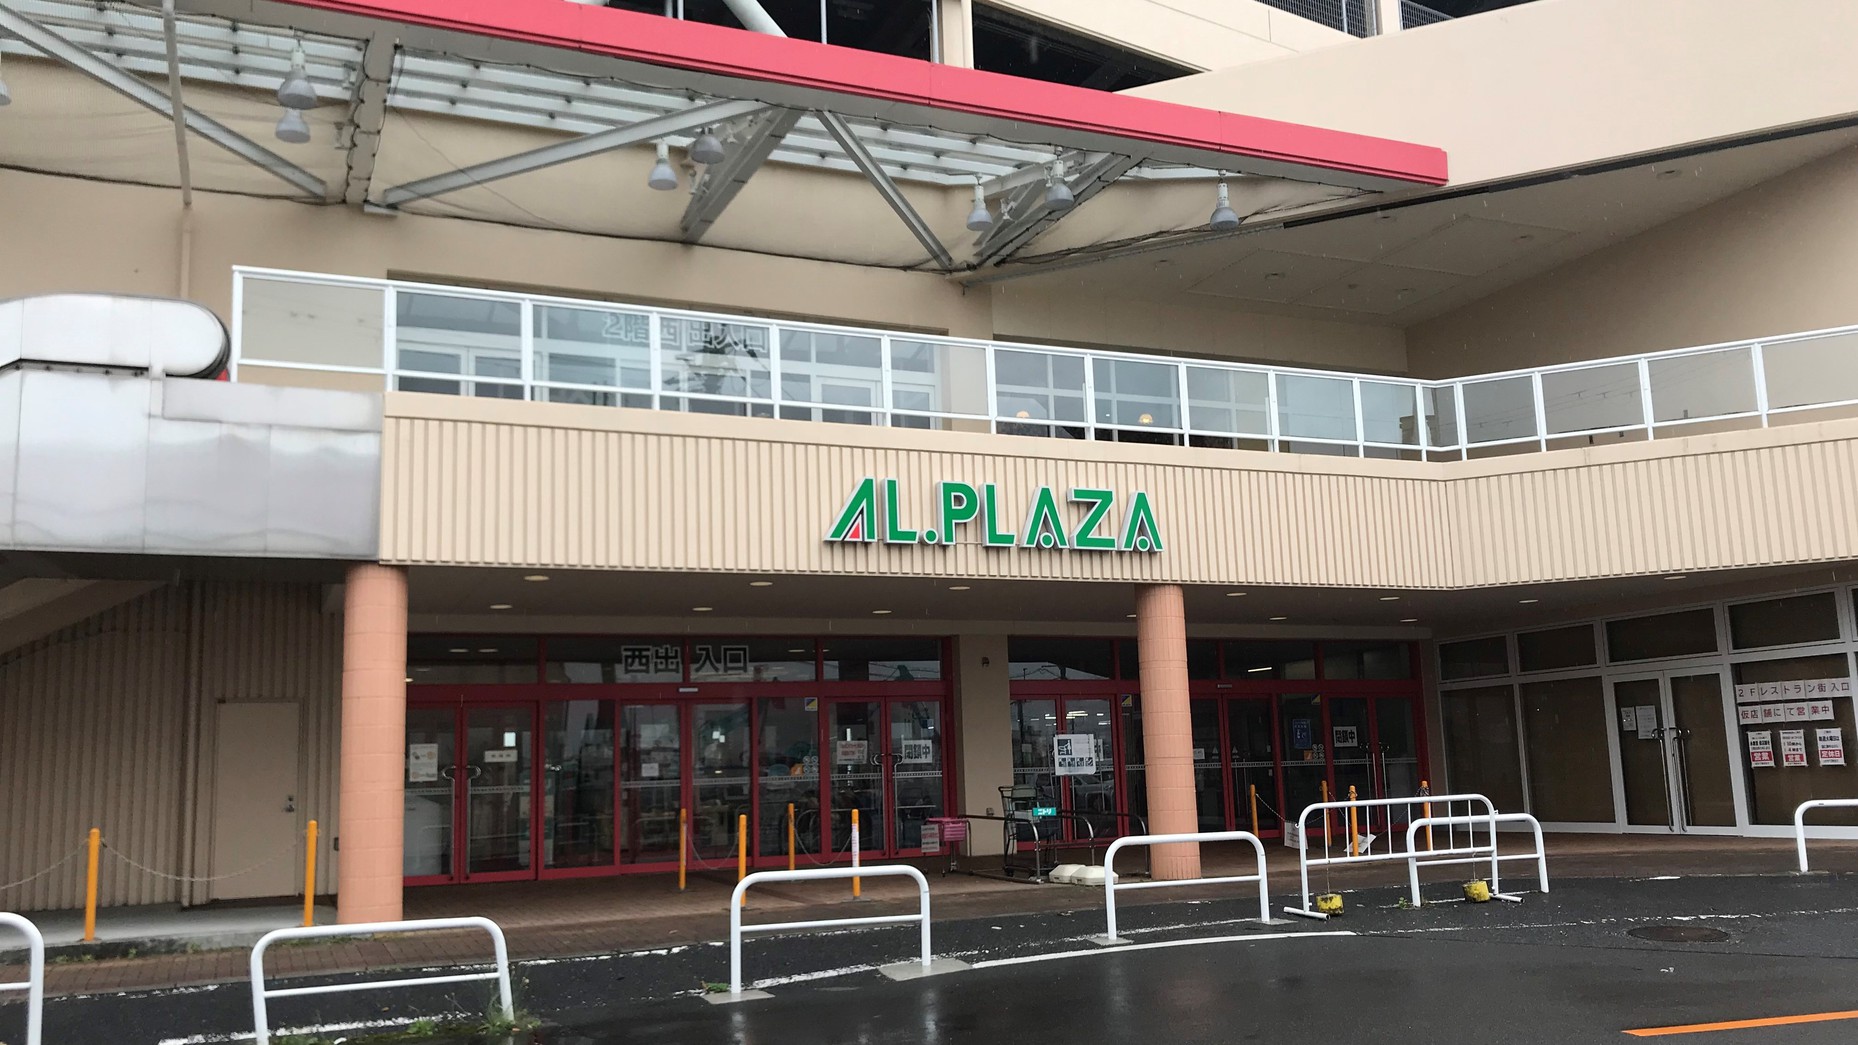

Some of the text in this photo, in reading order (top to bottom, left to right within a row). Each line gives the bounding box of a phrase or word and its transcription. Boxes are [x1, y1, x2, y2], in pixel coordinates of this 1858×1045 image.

[824, 476, 1164, 552] AL.PLAZA
[1741, 705, 1830, 719] 仮店舗にて営業中
[1753, 752, 1770, 760] 営業
[1821, 750, 1841, 758] 定休日
